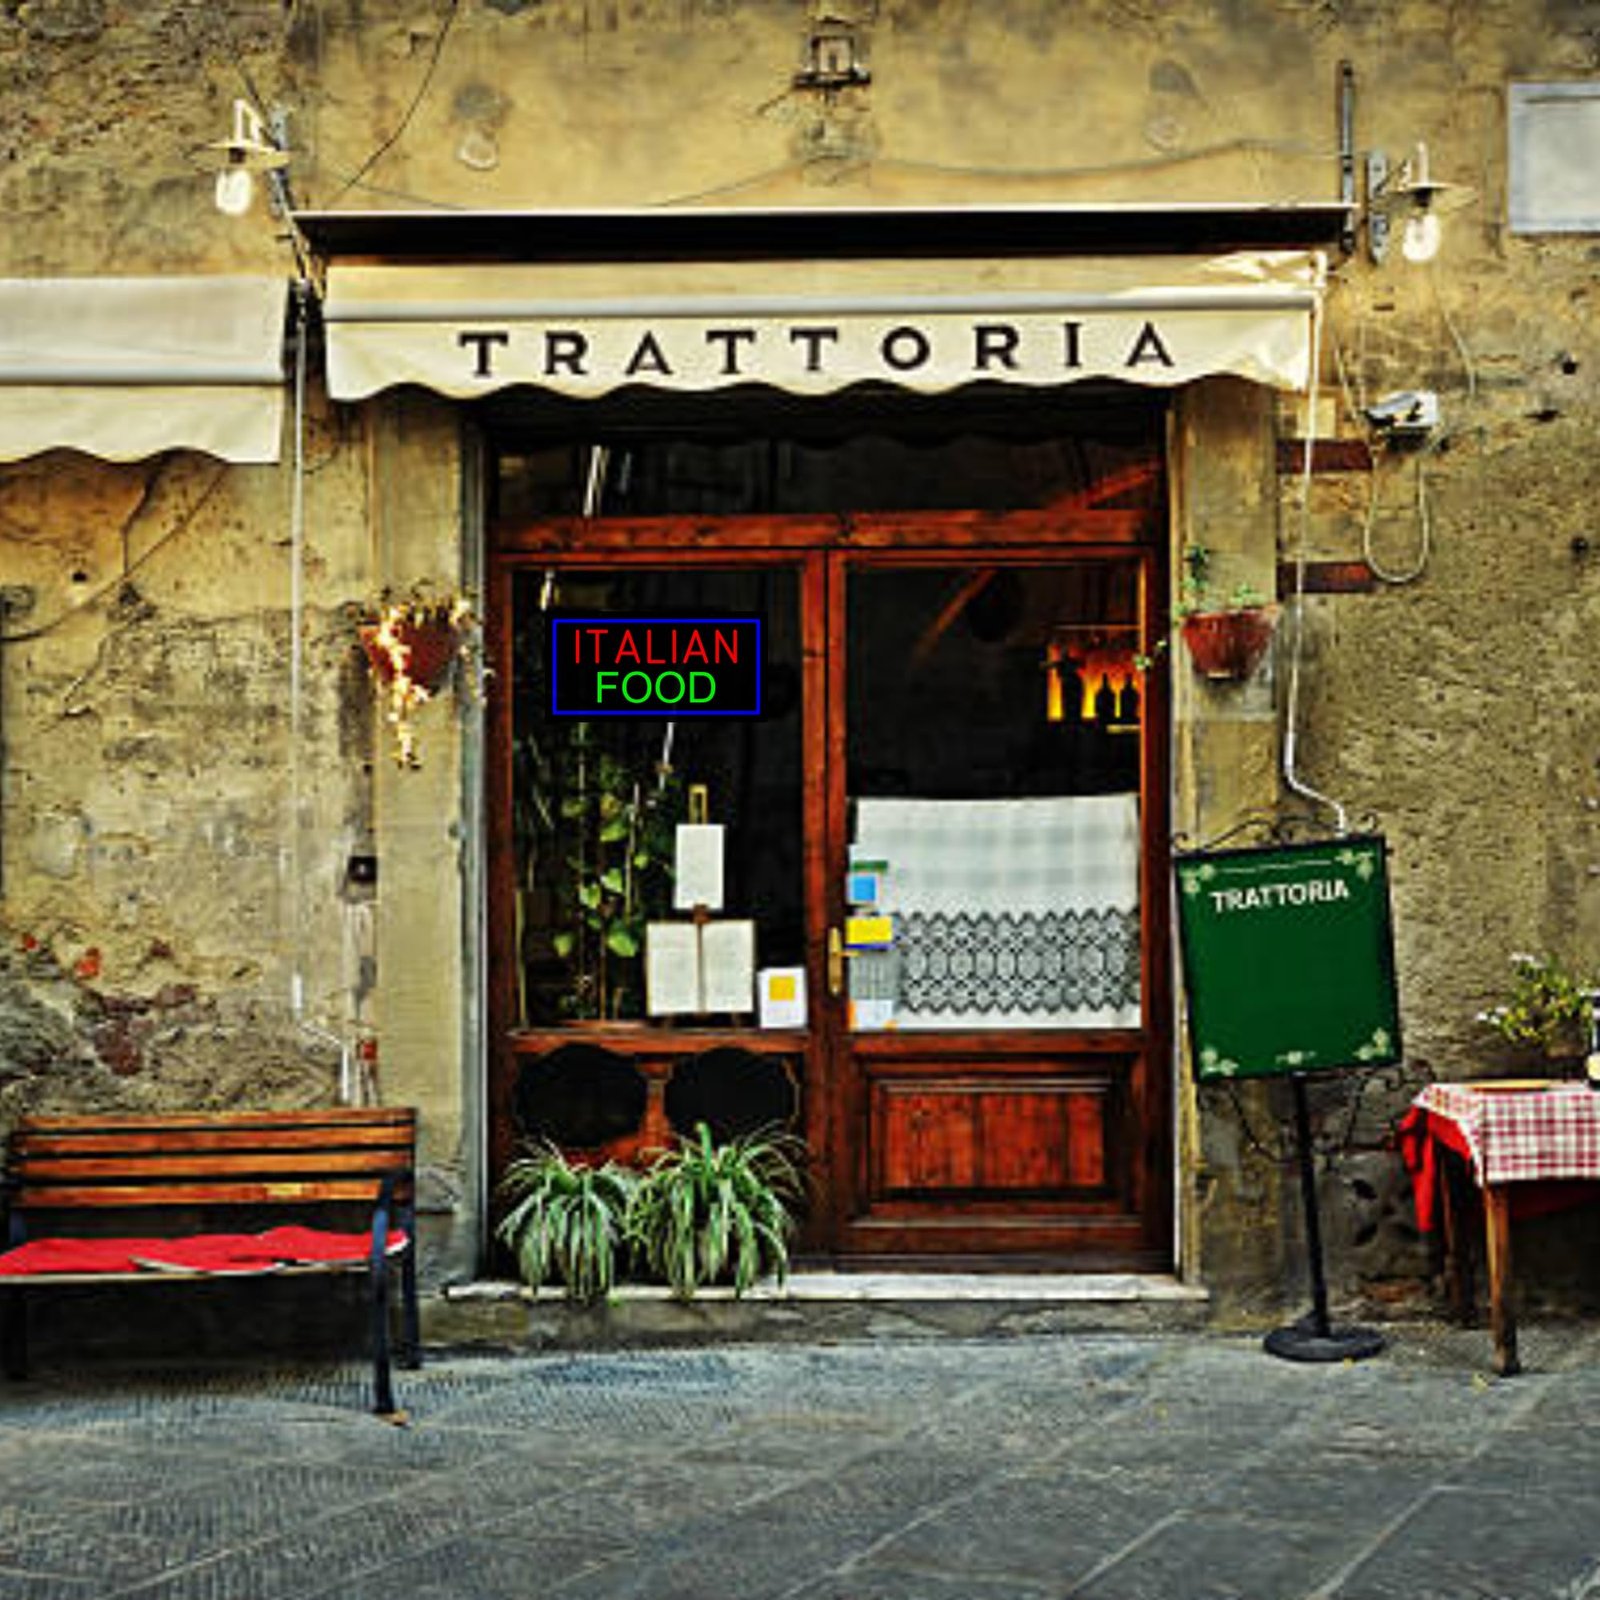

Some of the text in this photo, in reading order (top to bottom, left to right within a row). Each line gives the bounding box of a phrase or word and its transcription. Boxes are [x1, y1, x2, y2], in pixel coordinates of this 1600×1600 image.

[458, 321, 1175, 376] TRATTORIA
[575, 629, 738, 664] ITALIAN
[597, 671, 716, 703] FOOD
[1210, 879, 1349, 913] TRATTORIA
